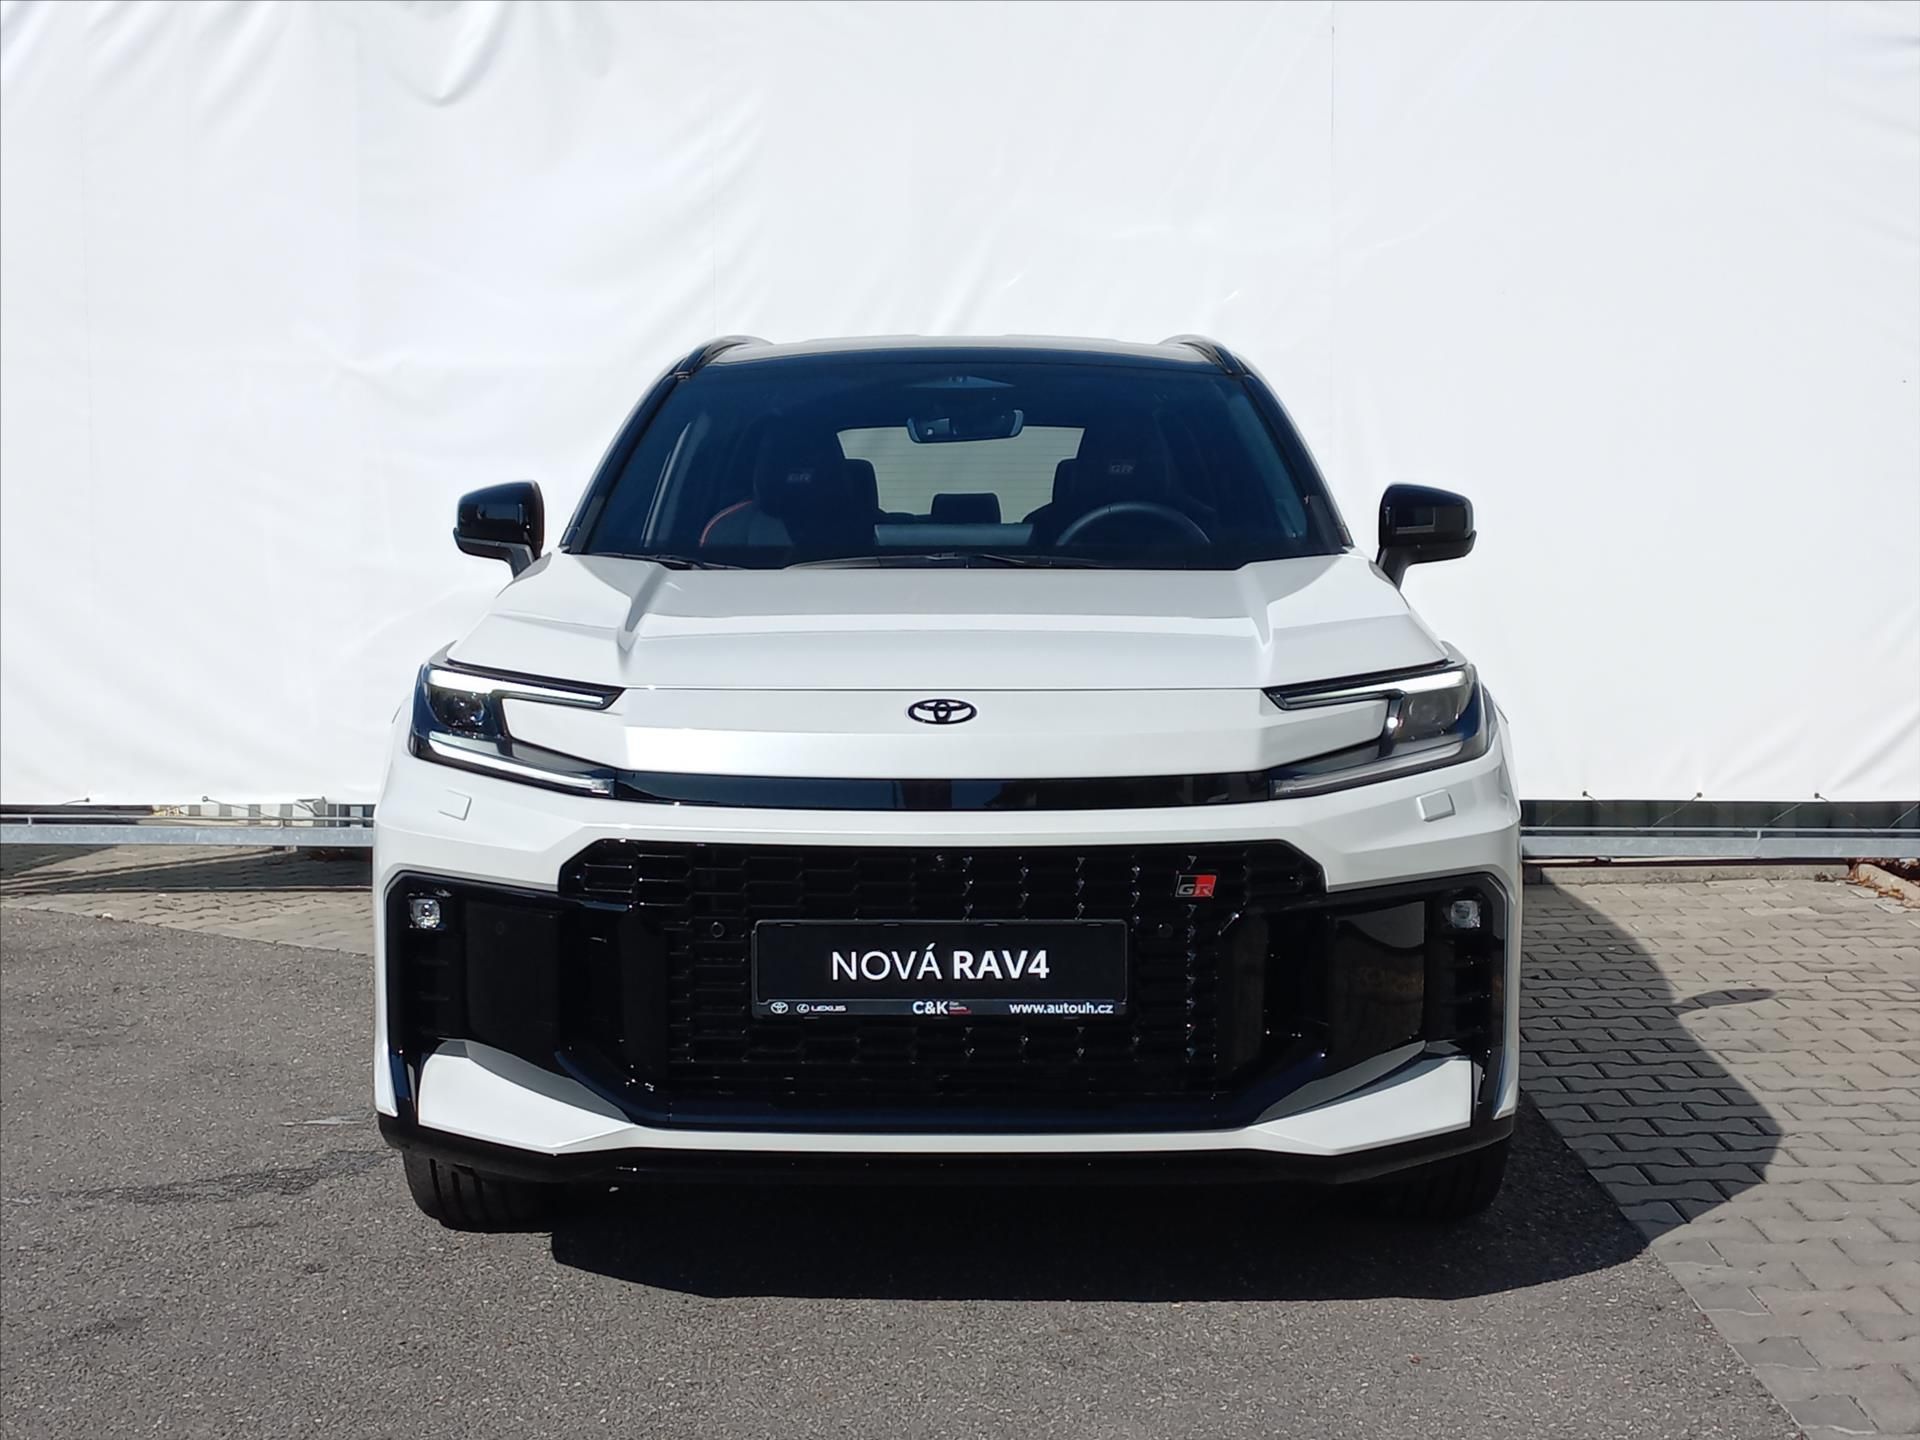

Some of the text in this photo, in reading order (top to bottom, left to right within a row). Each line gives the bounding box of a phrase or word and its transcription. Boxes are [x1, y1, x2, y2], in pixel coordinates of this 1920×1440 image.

[1178, 884, 1212, 896] GR
[831, 942, 1050, 981] NOVÁ RAV4
[810, 1004, 847, 1012] LEXUS
[912, 1000, 949, 1015] C&K
[1008, 1001, 1115, 1015] www.autouh.cz
